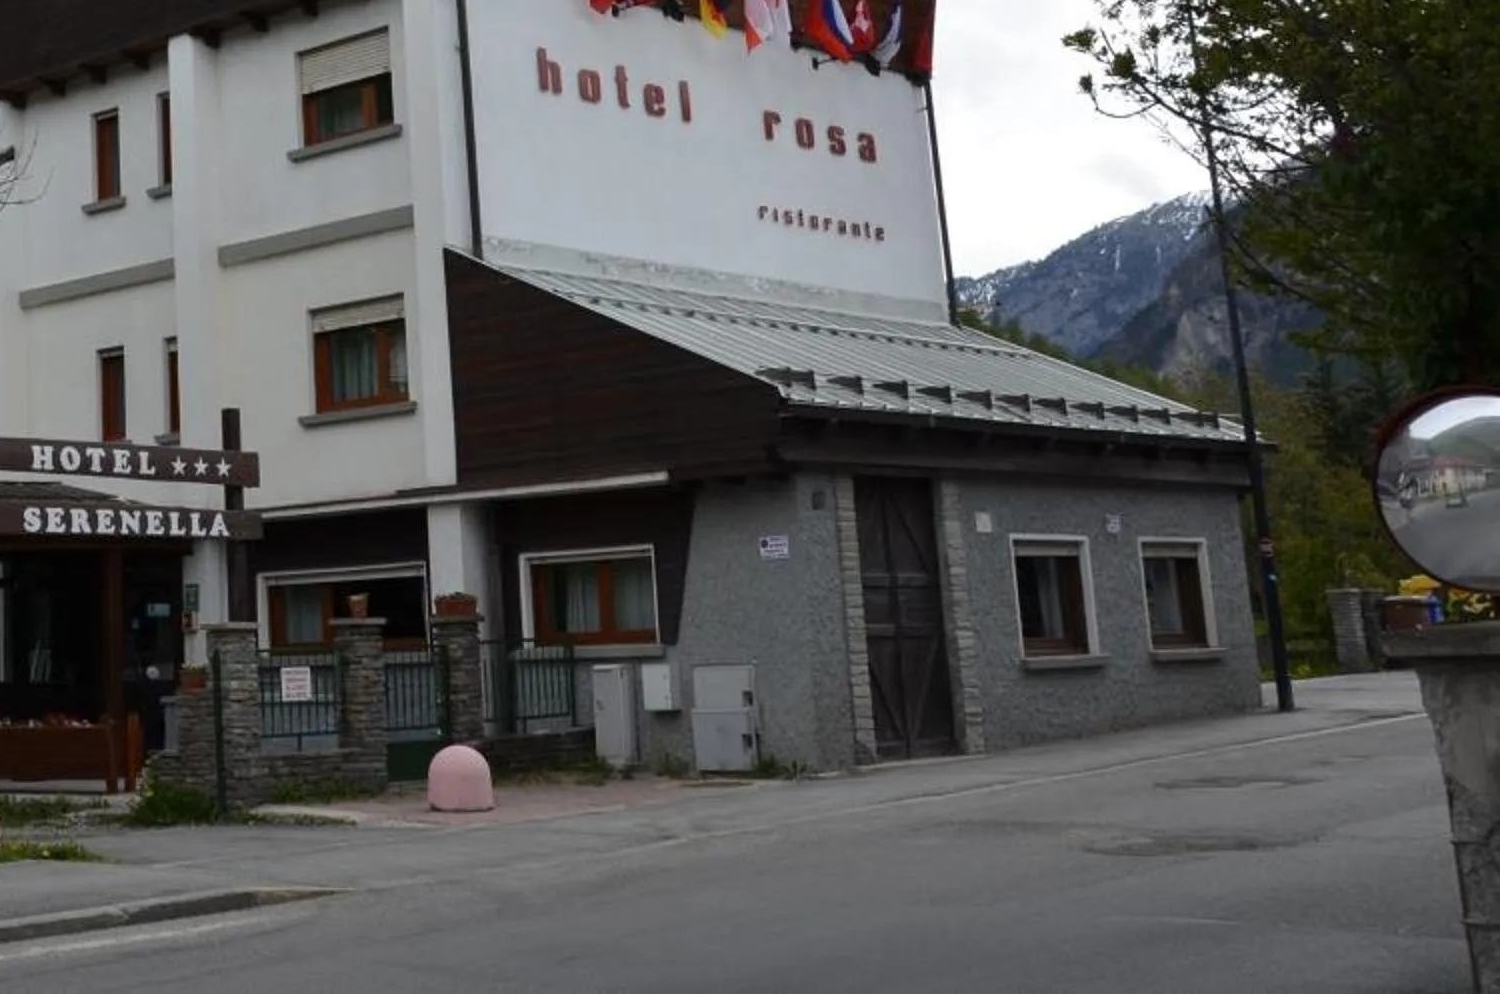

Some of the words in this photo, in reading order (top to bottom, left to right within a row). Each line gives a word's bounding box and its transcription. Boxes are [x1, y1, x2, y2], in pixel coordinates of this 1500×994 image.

[536, 46, 693, 124] hotel
[762, 108, 878, 164] rosa
[758, 205, 886, 242] ristorante
[32, 444, 156, 475] HOTEL
[23, 506, 231, 538] SERENELLA
